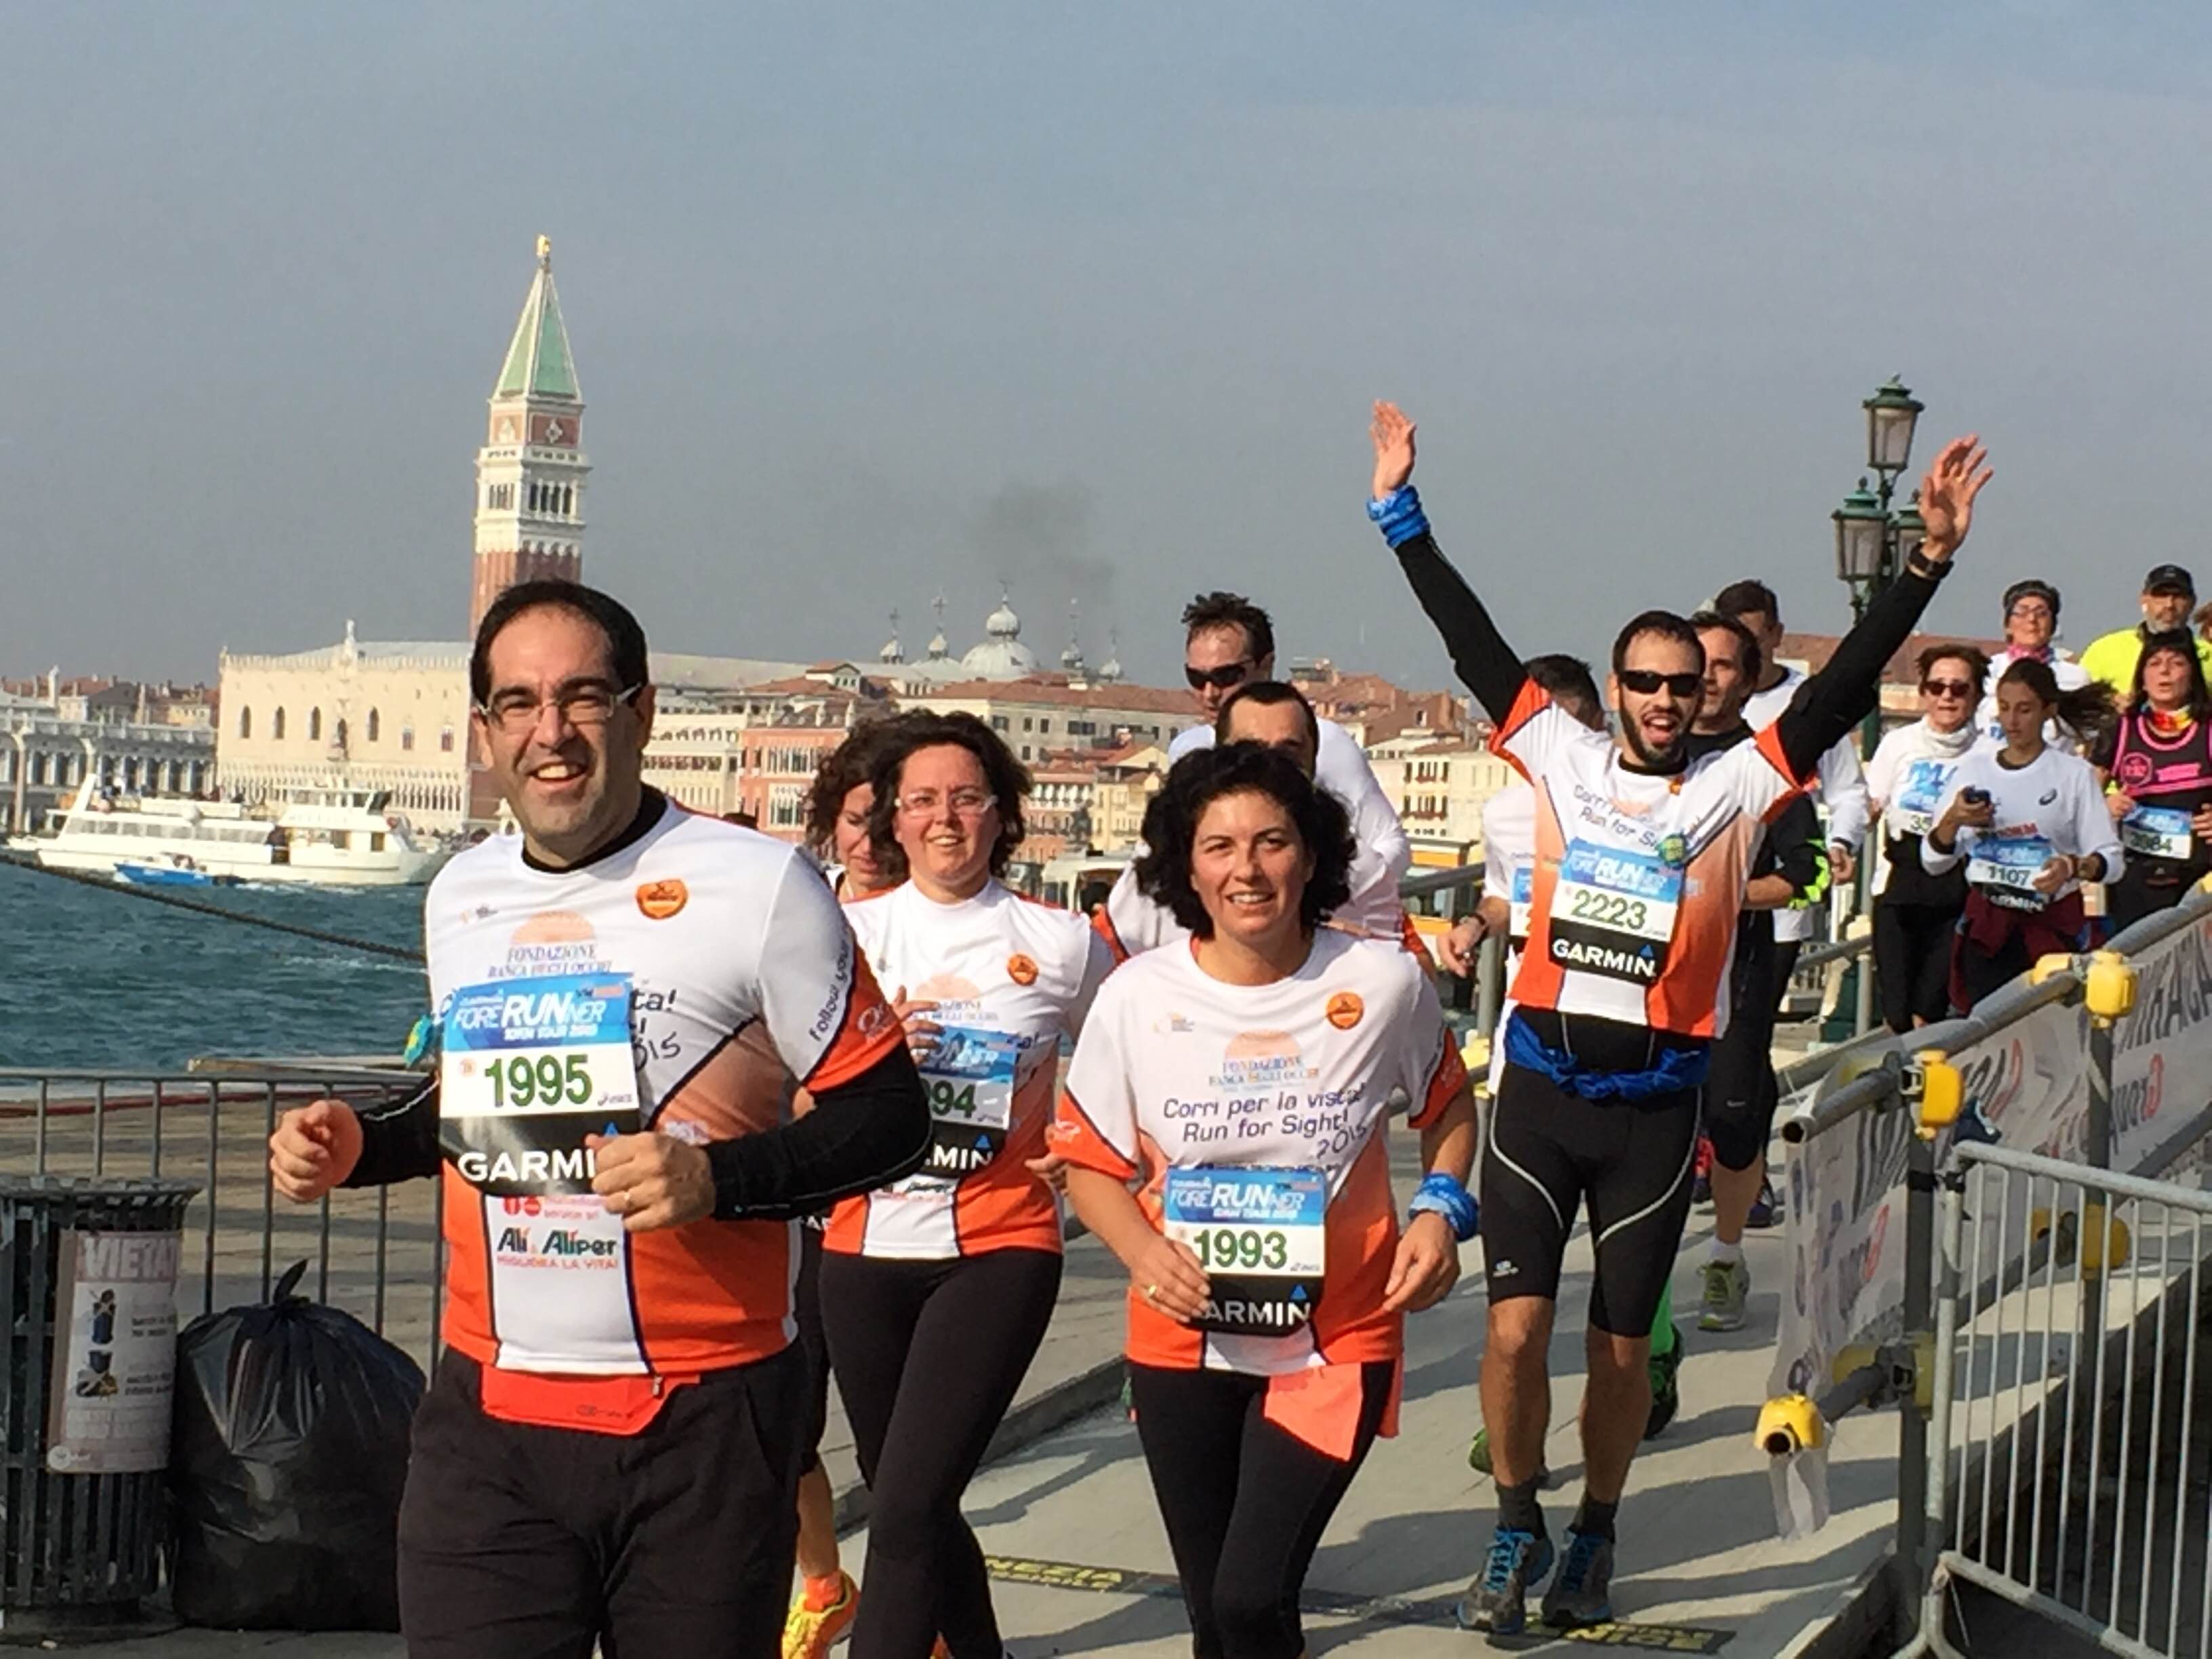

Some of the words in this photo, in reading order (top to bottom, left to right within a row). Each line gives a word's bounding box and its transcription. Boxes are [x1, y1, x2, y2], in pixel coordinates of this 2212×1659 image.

[1988, 865, 2031, 886] 1107
[1571, 889, 1647, 930] 2223
[1552, 938, 1656, 977] GARMIN
[630, 989, 678, 1012] ta!
[484, 1054, 593, 1108] 1995
[923, 1079, 977, 1119] 94
[1164, 1097, 1219, 1119] Corri
[1227, 1097, 1269, 1120] per
[1277, 1092, 1297, 1111] la
[1183, 1122, 1228, 1143] Run
[1238, 1118, 1273, 1139] for
[1281, 1109, 1349, 1139] Sight!
[457, 1149, 595, 1182] GARMI
[927, 1144, 994, 1170] MIN
[1193, 1229, 1288, 1270] 1993
[1205, 1300, 1311, 1326] ARMIN
